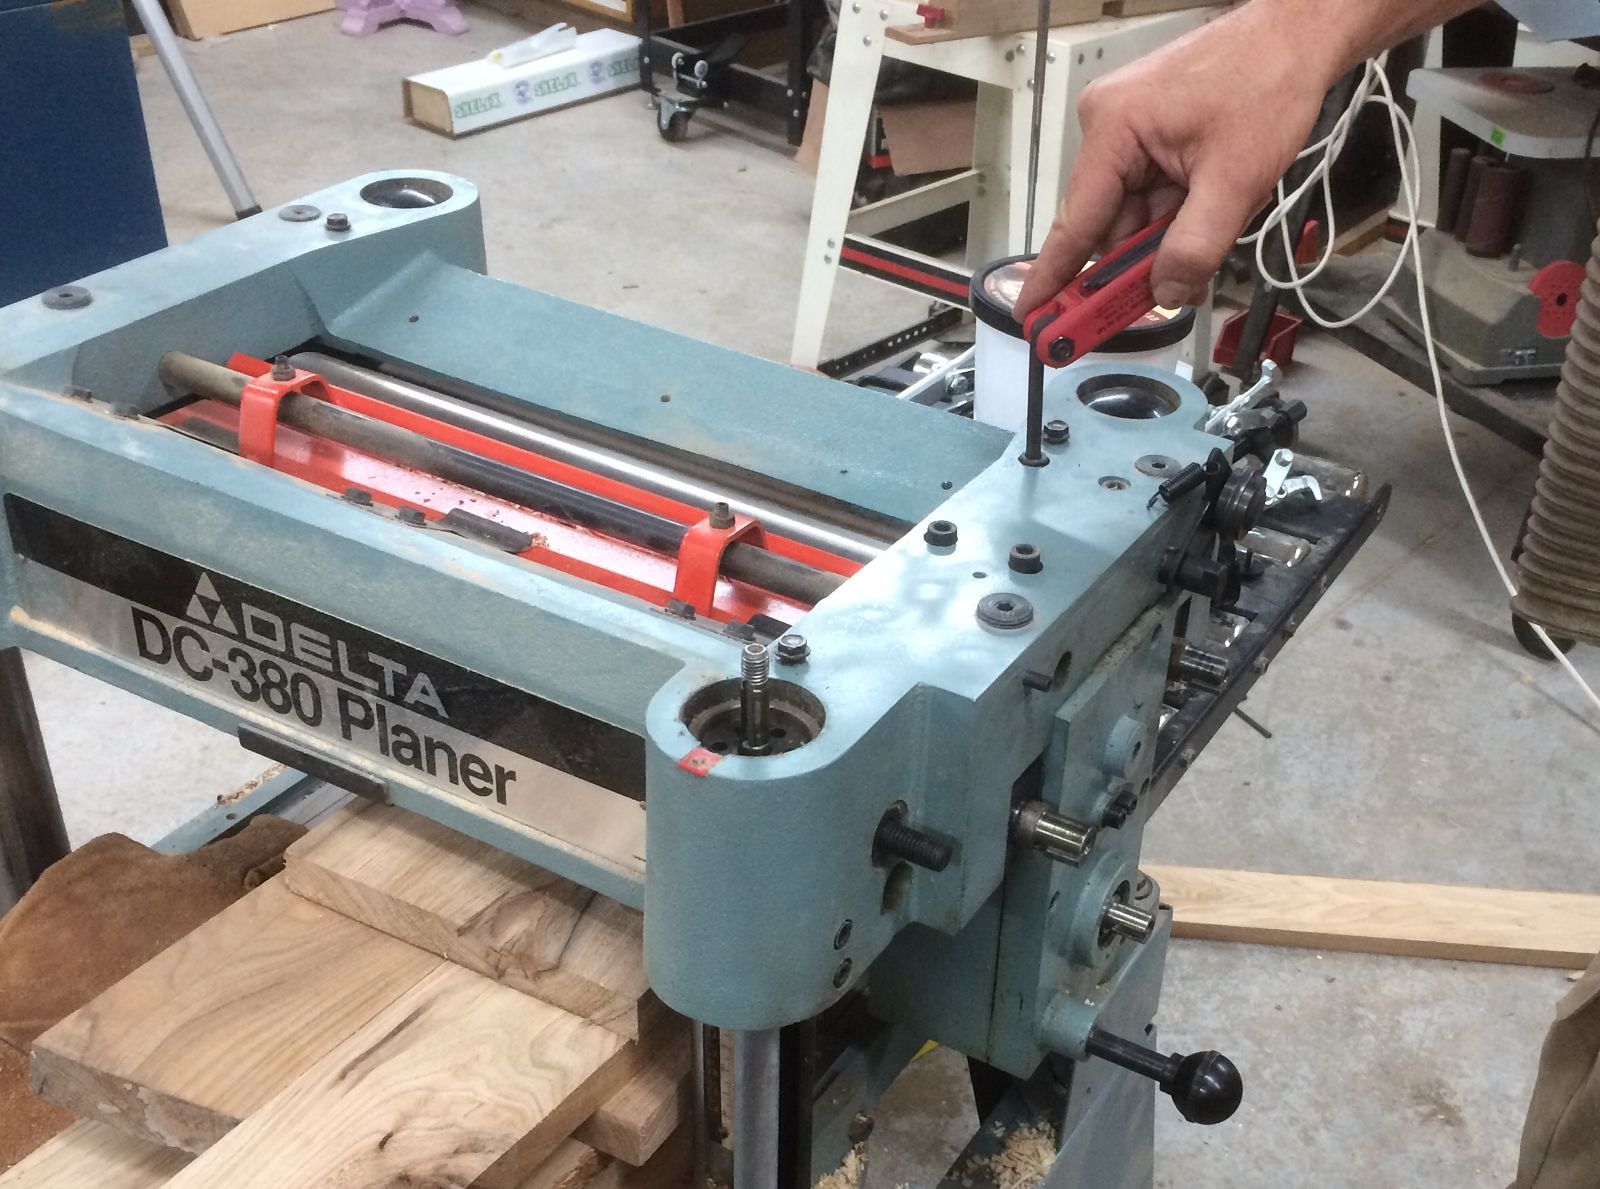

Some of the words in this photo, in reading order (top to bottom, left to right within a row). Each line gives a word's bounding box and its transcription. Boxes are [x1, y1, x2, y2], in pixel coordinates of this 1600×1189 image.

[131, 606, 322, 727] DC-380
[337, 687, 516, 806] Planer
[241, 602, 449, 718] DELTA
